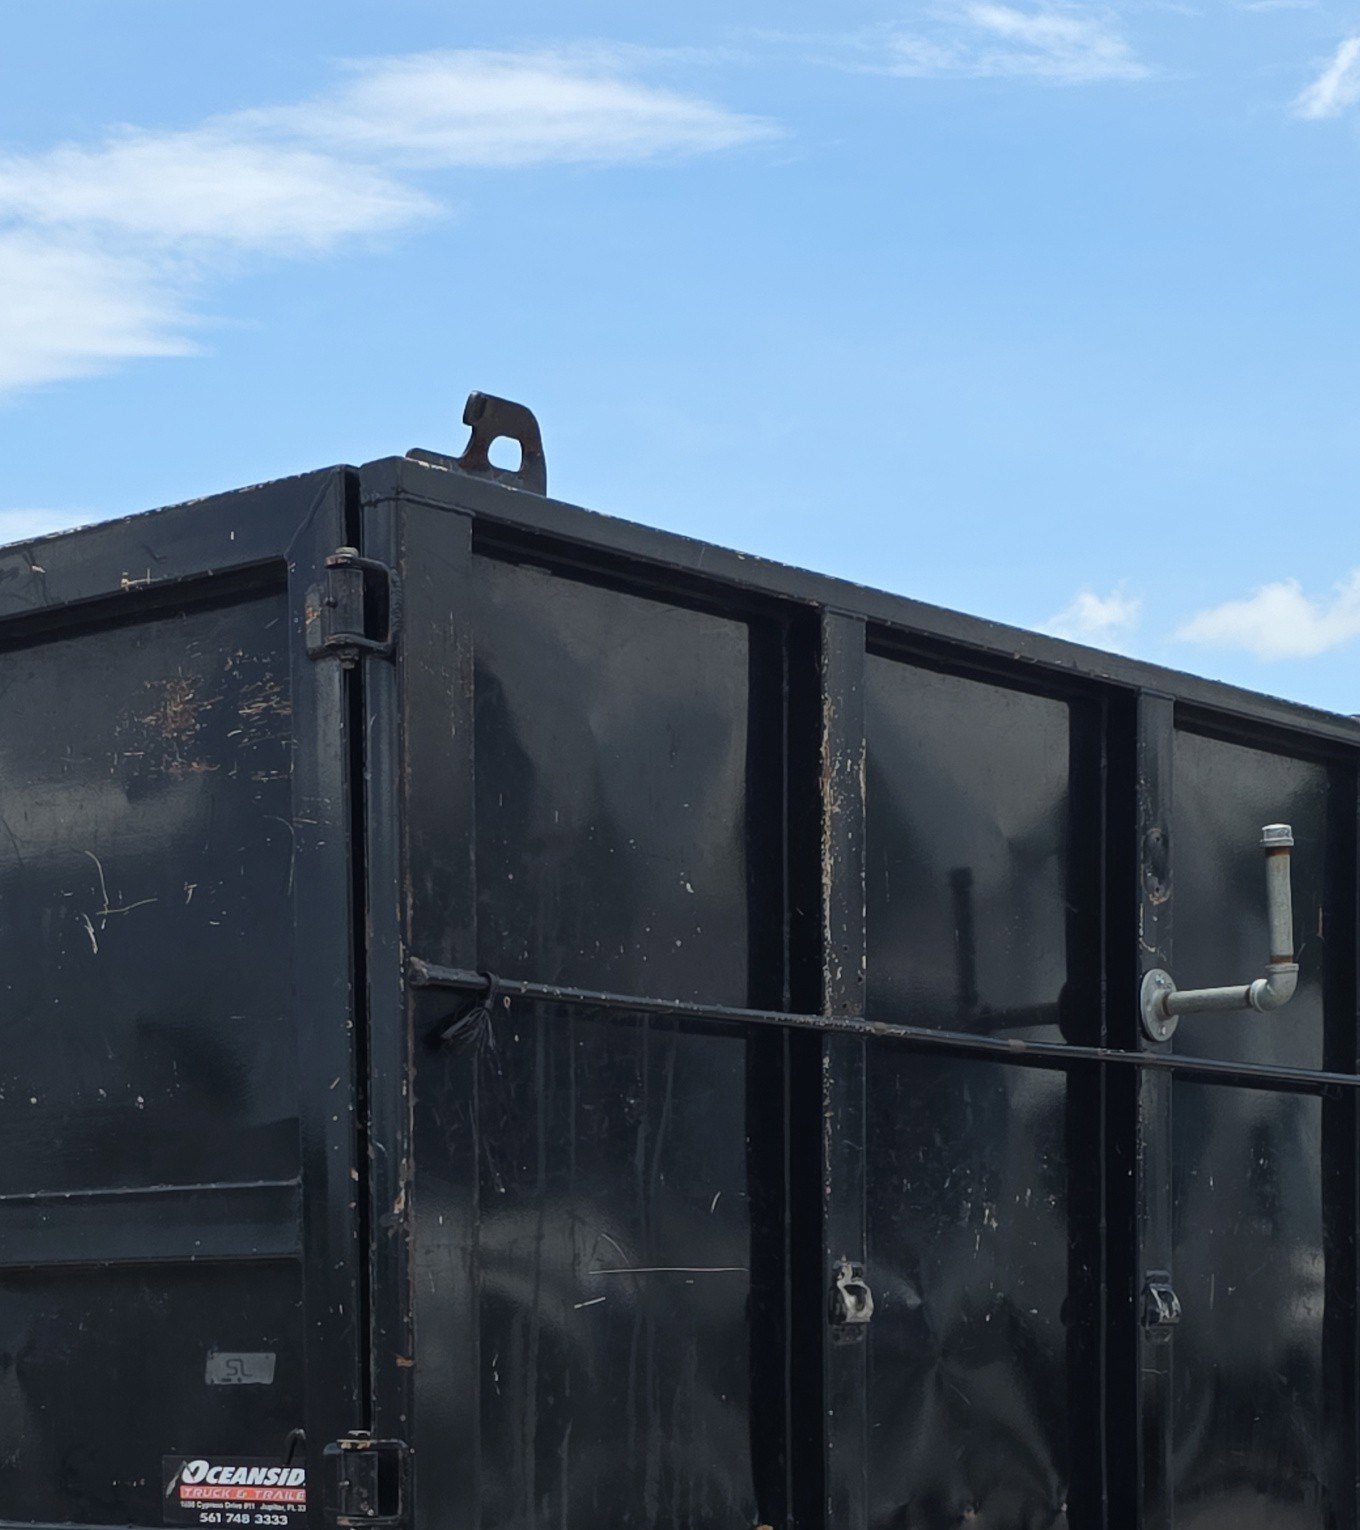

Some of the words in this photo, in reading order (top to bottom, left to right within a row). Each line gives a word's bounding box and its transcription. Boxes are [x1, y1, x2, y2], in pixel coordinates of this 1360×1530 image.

[181, 1459, 307, 1487] OCEANSID
[184, 1487, 232, 1498] TRUCK
[199, 1512, 222, 1523] 561
[225, 1513, 251, 1524] 748
[254, 1514, 288, 1525] 3333
